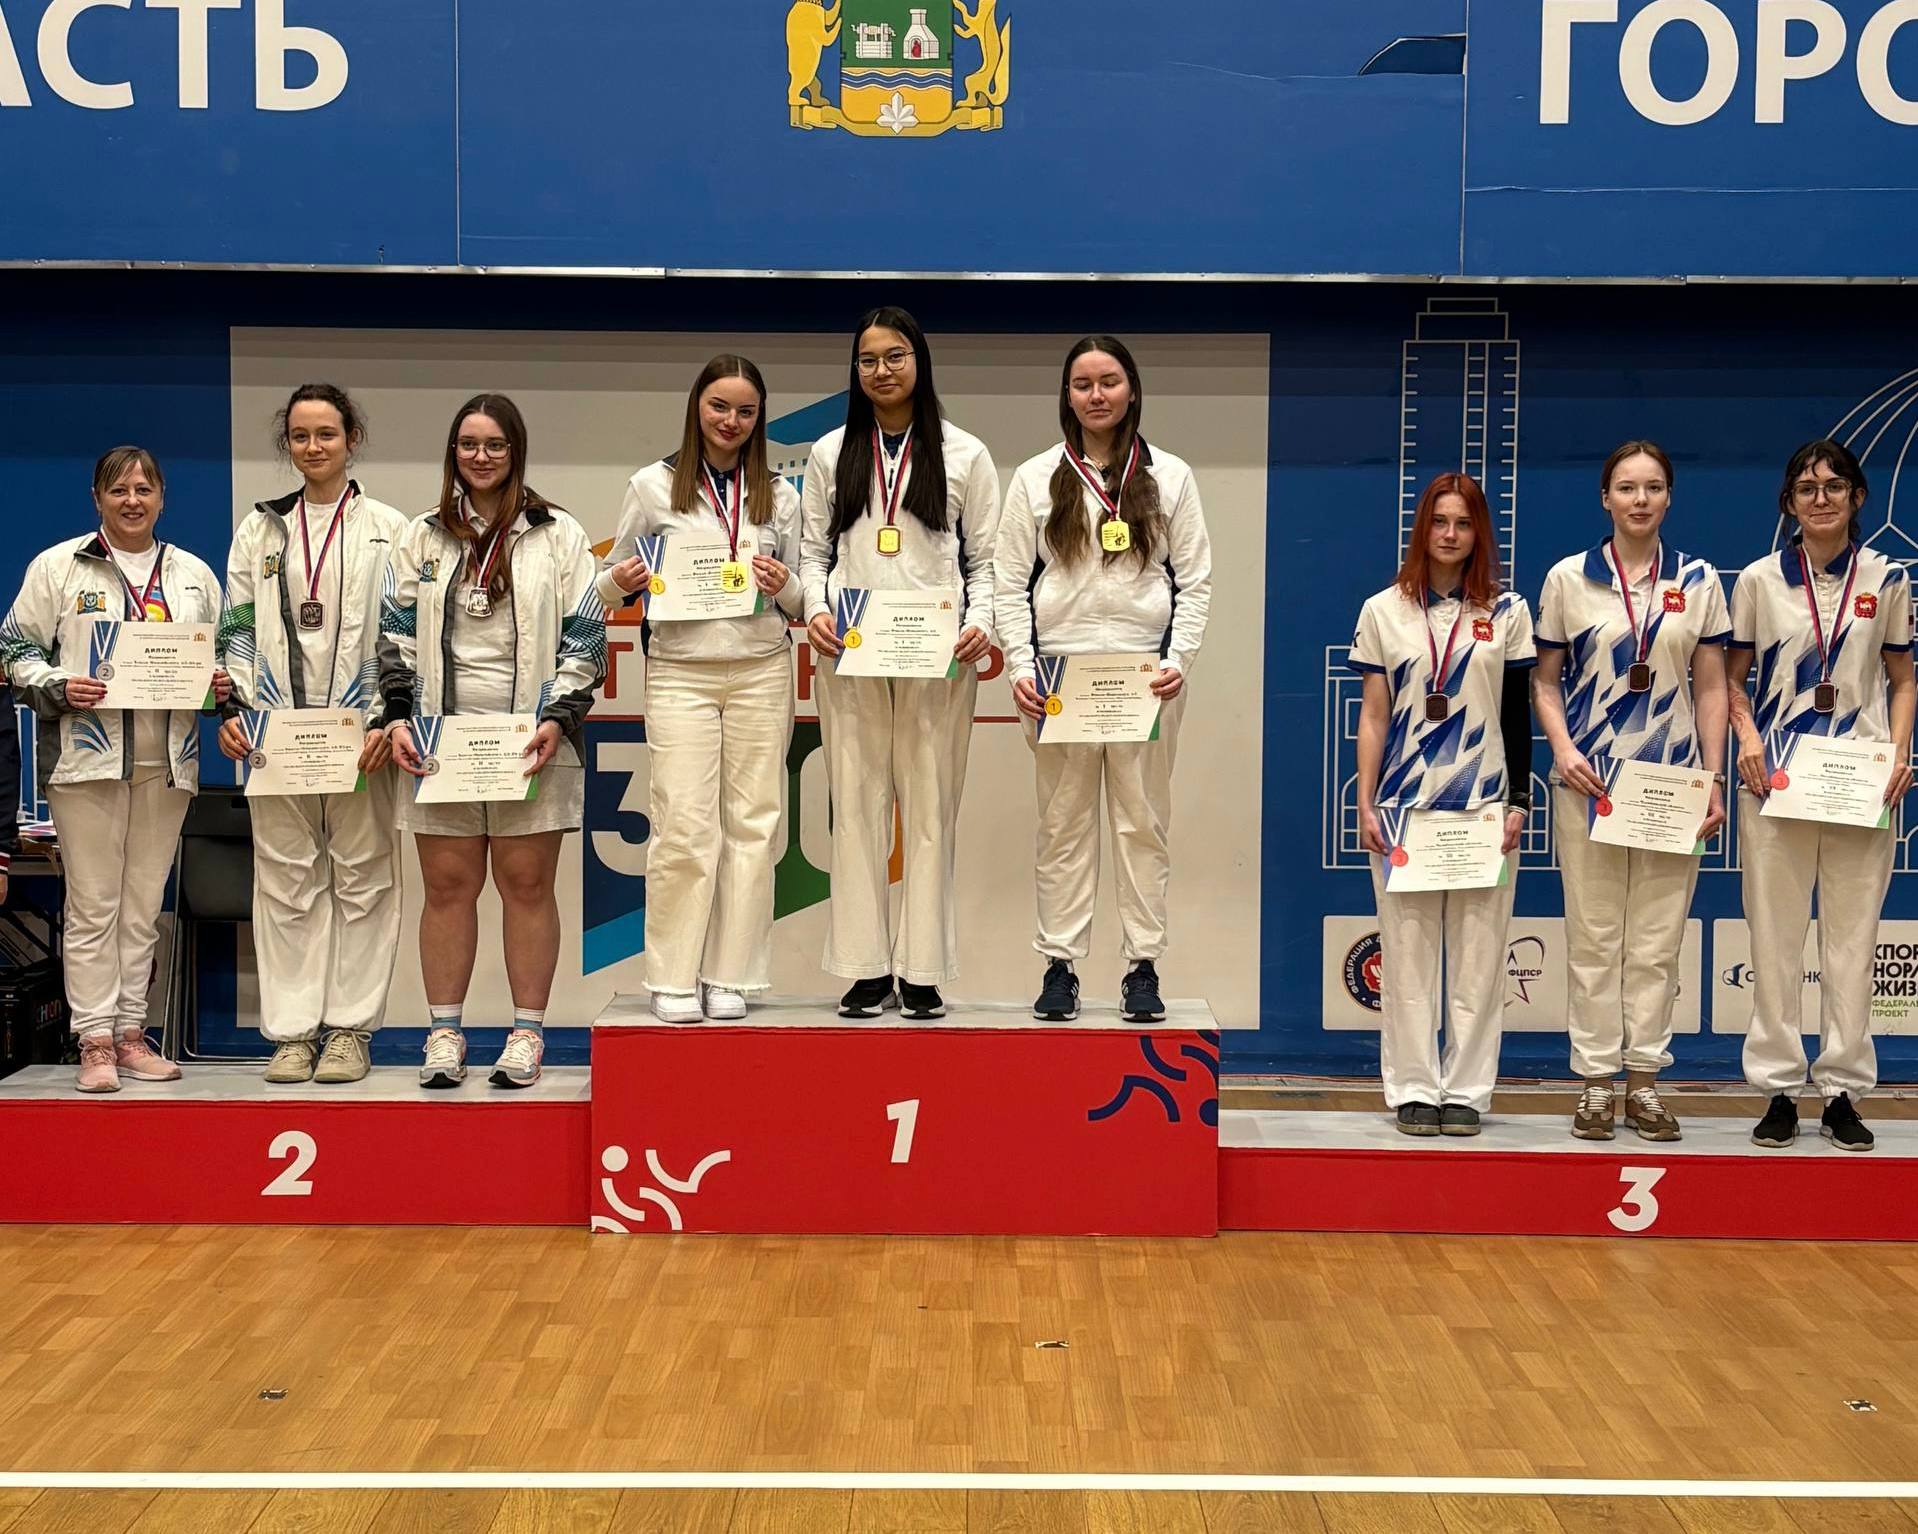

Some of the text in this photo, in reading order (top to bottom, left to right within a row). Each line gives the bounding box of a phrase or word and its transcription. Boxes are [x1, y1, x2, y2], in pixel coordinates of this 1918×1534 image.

[0, 0, 349, 111] СТЬ
[102, 668, 109, 677] 2
[255, 756, 261, 764] 2
[428, 763, 434, 771] 2
[1508, 969, 1543, 978] ФЦПСР
[1872, 1010, 1909, 1018] ПРОЕКТ
[887, 1100, 919, 1162] 1
[262, 1131, 316, 1195] 2
[1607, 1167, 1667, 1231] 3
